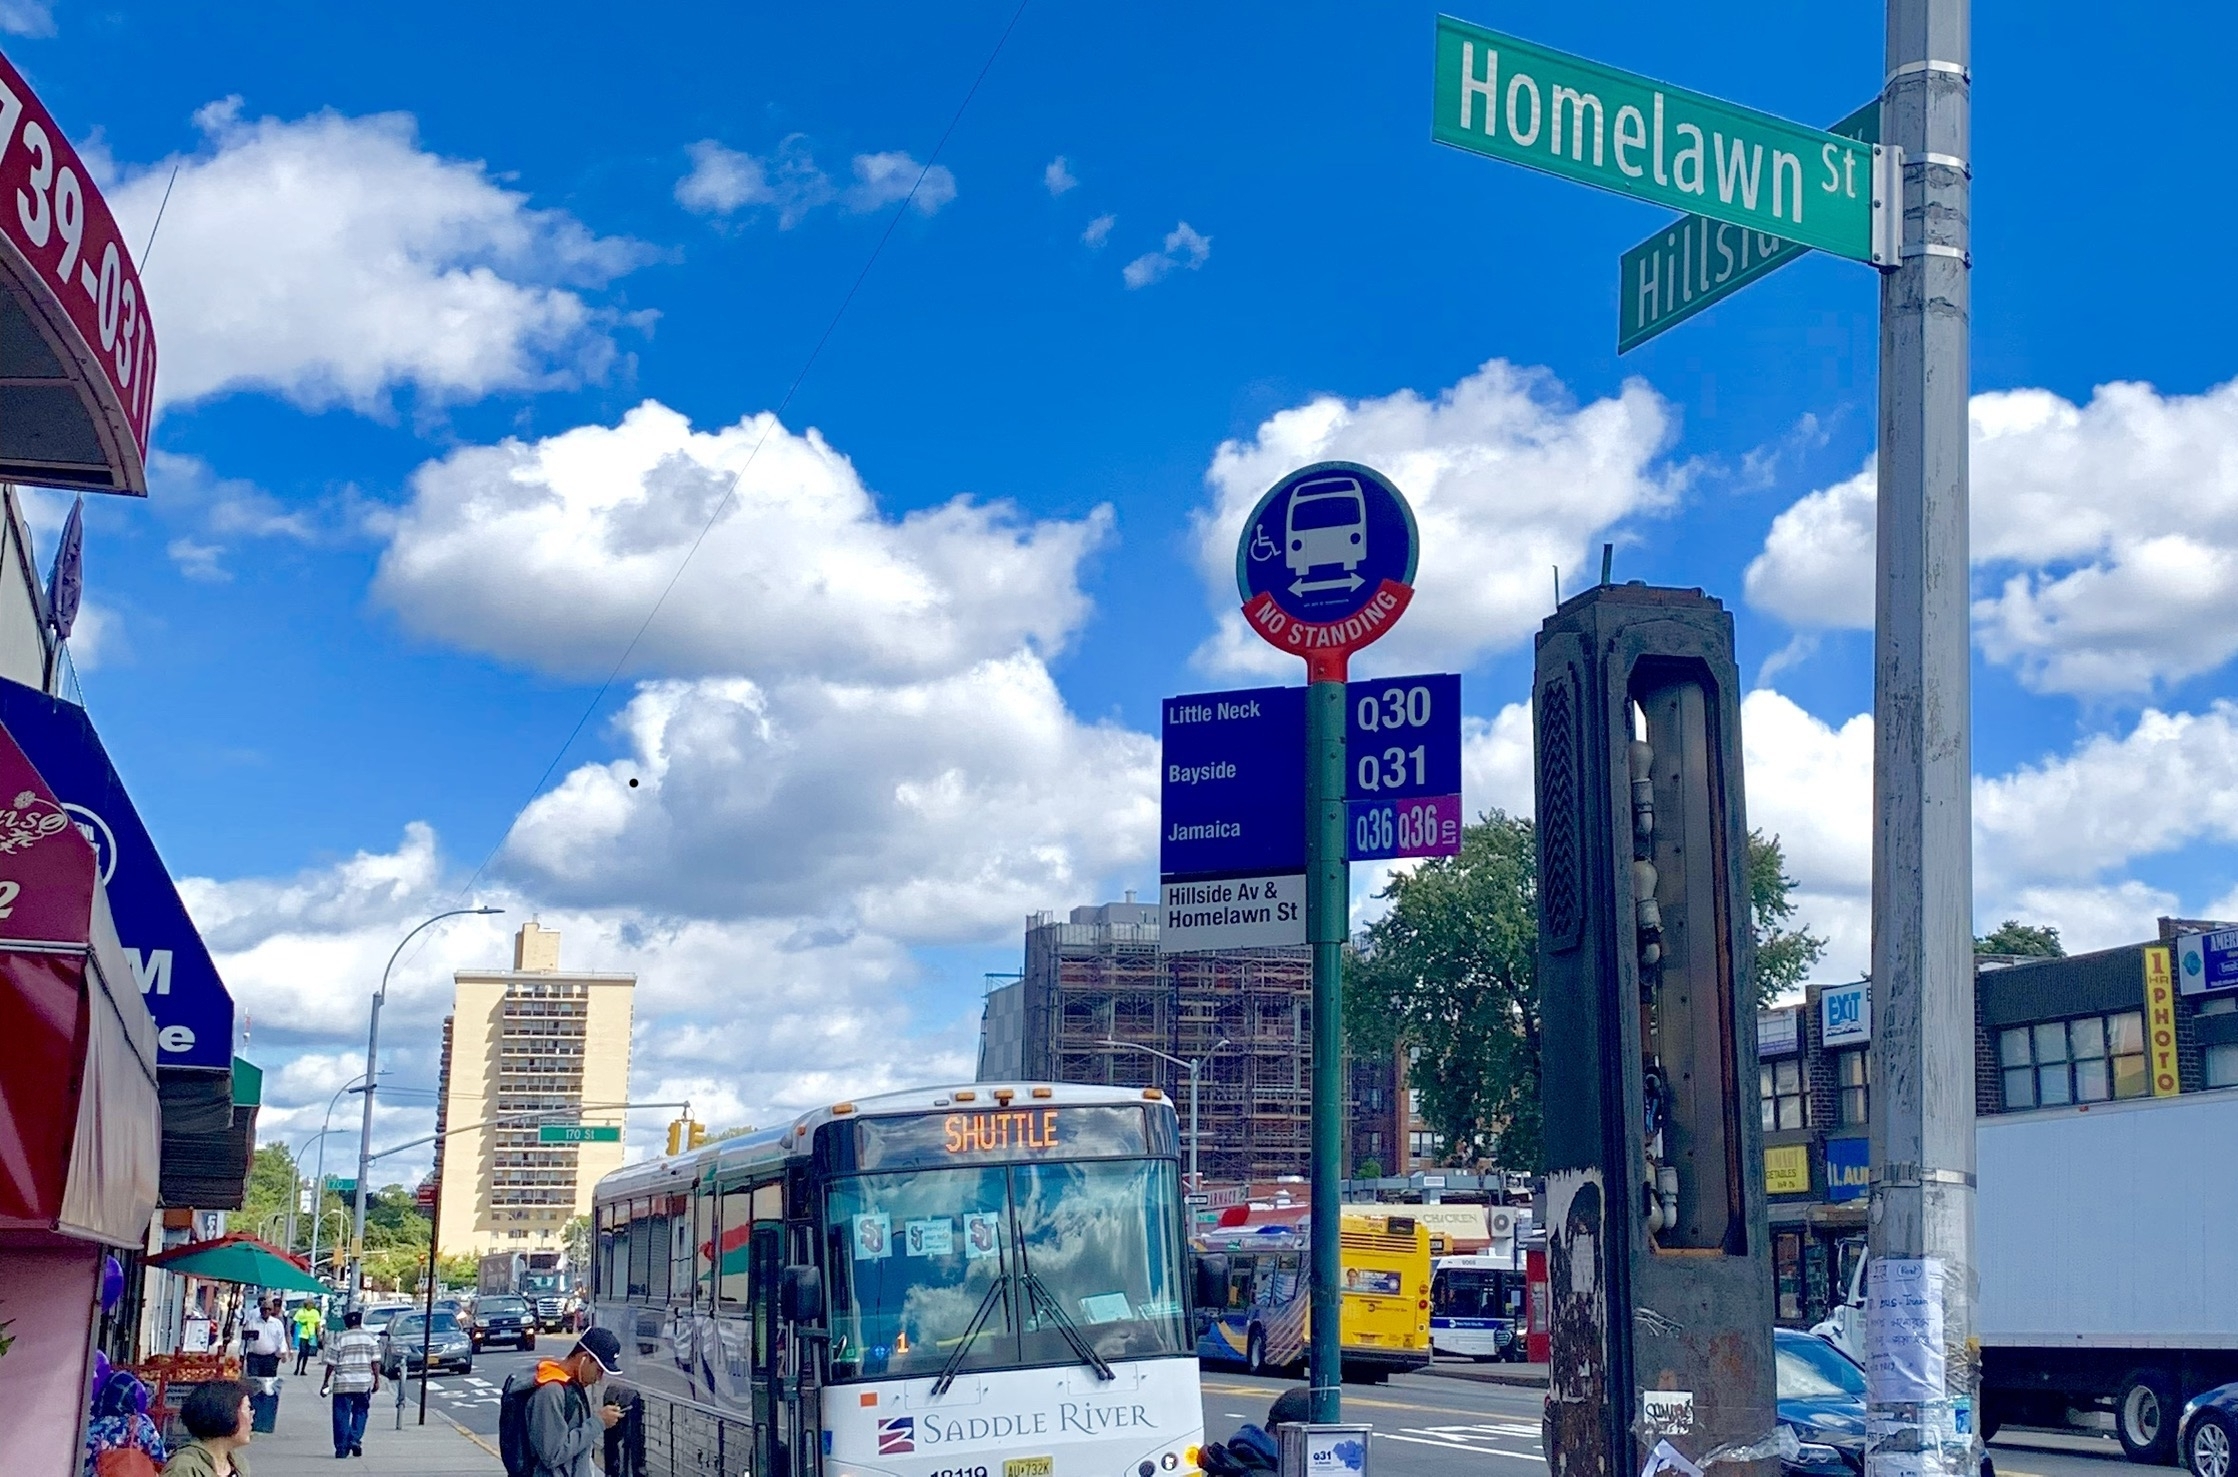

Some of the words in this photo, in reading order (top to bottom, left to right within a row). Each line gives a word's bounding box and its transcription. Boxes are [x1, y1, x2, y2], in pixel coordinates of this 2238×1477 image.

[1460, 41, 1802, 223] Homelawn
[1822, 142, 1857, 198] St
[1255, 600, 1286, 633] NO
[1287, 590, 1398, 648] STANDING
[1169, 704, 1213, 724] Little
[1217, 700, 1261, 720] Neck
[1357, 686, 1431, 733] Q30
[1169, 761, 1237, 785] Bayside
[1358, 745, 1425, 792] Q31
[1168, 820, 1241, 842] Jamaica
[1357, 807, 1393, 852] Q36
[1398, 804, 1438, 850] Q36
[1442, 820, 1457, 845] LTD
[1169, 884, 1232, 906] Hillside
[1237, 883, 1259, 901] Av
[1264, 882, 1278, 899] &
[1169, 906, 1271, 928] Homelawn
[1277, 902, 1298, 921] St
[2151, 953, 2164, 974] 1
[2149, 976, 2169, 984] HR
[1828, 991, 1861, 1027] EXIT
[2153, 987, 2175, 1092] PHOTO
[566, 1128, 580, 1140] 170
[584, 1129, 595, 1140] St
[944, 1111, 1059, 1153] SHUTTLE
[1423, 1214, 1477, 1224] CHICKEN
[897, 1331, 909, 1353] 1
[924, 1413, 1047, 1444] SADDLE
[1059, 1401, 1158, 1435] RIVER
[1313, 1450, 1331, 1460] Q31
